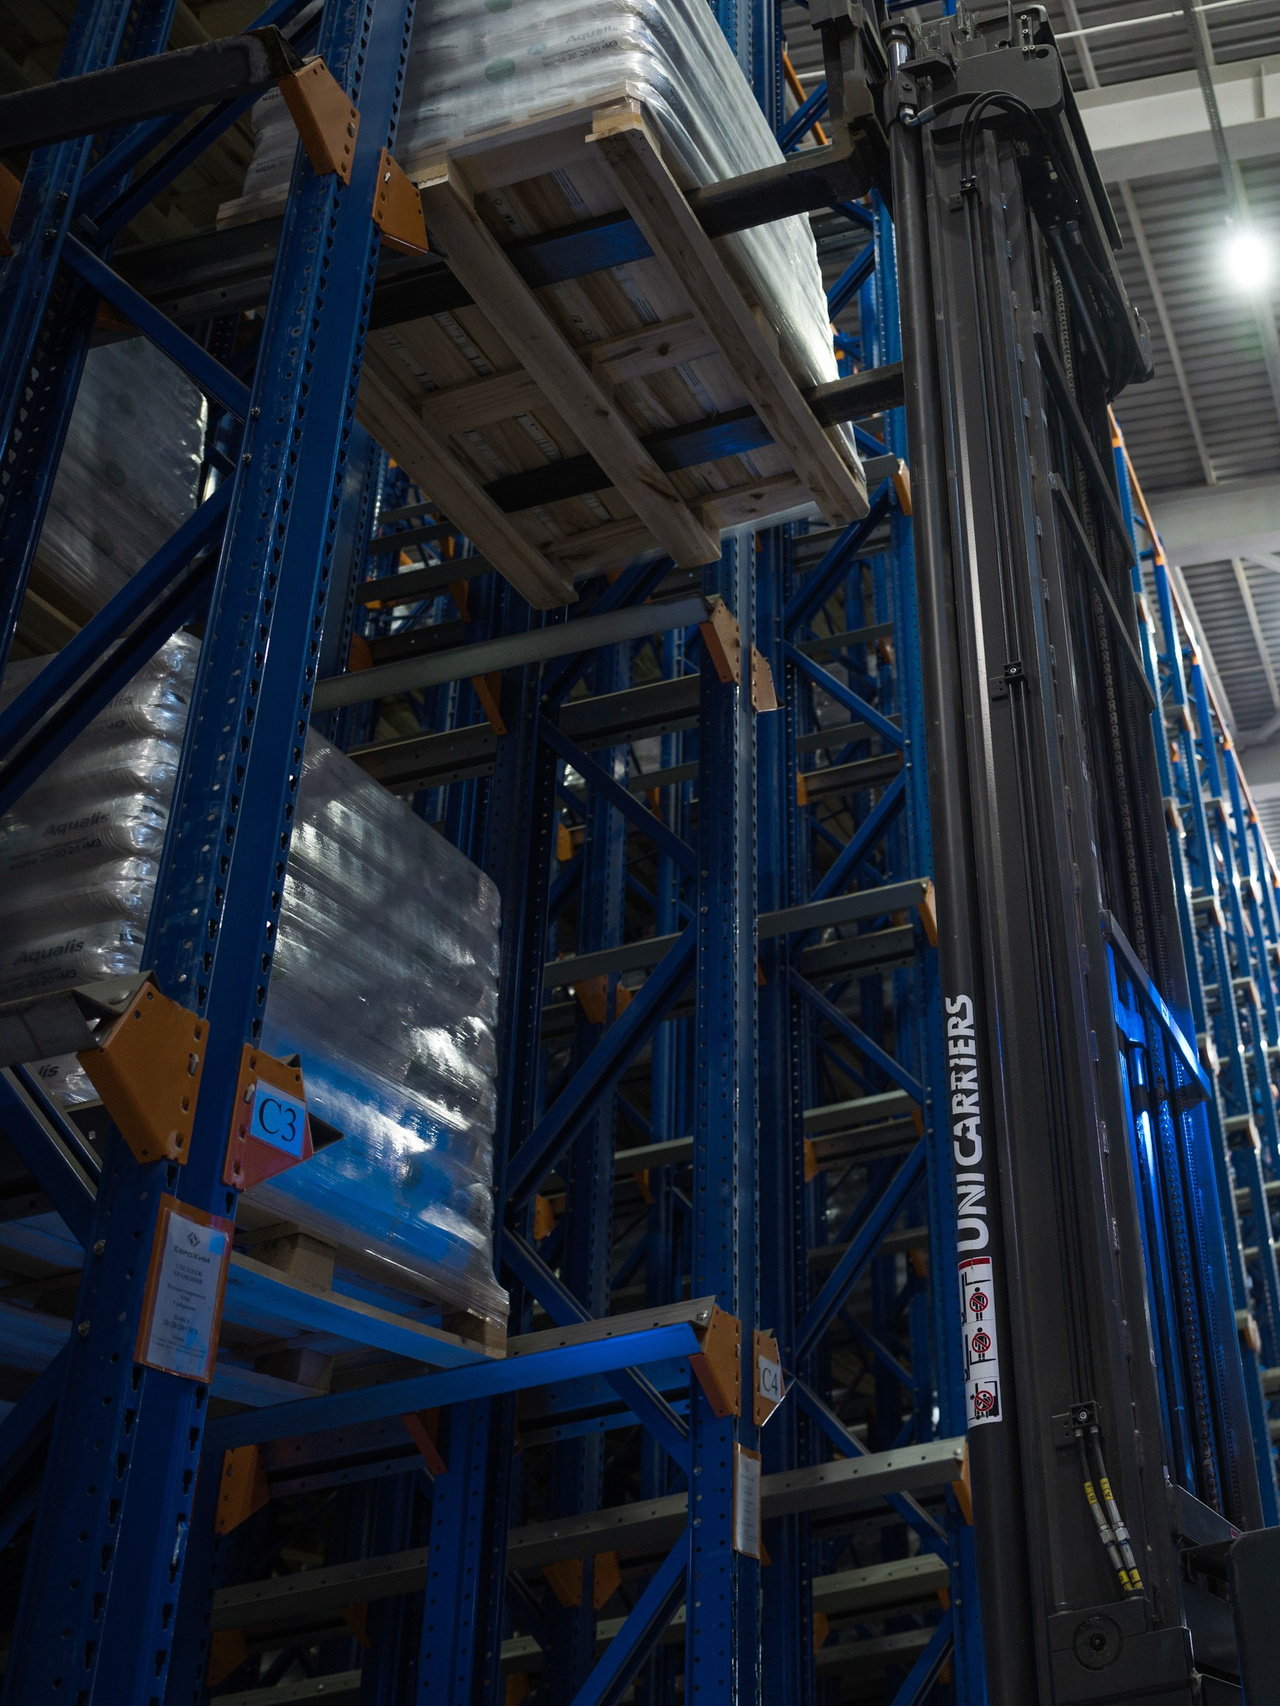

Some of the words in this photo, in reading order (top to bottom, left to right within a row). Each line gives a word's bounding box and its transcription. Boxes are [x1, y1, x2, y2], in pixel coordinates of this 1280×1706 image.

[565, 25, 618, 44] Aqualis
[567, 46, 601, 60] 20-20-20
[42, 811, 109, 837] Aqualis
[40, 846, 80, 863] 20-20-20
[82, 838, 102, 850] +МЭ
[13, 939, 85, 966] Aqualis
[11, 975, 54, 993] 20-20-20
[258, 1098, 297, 1142] C3
[945, 993, 991, 1256] UNICARRIERS
[762, 1368, 779, 1395] C4
